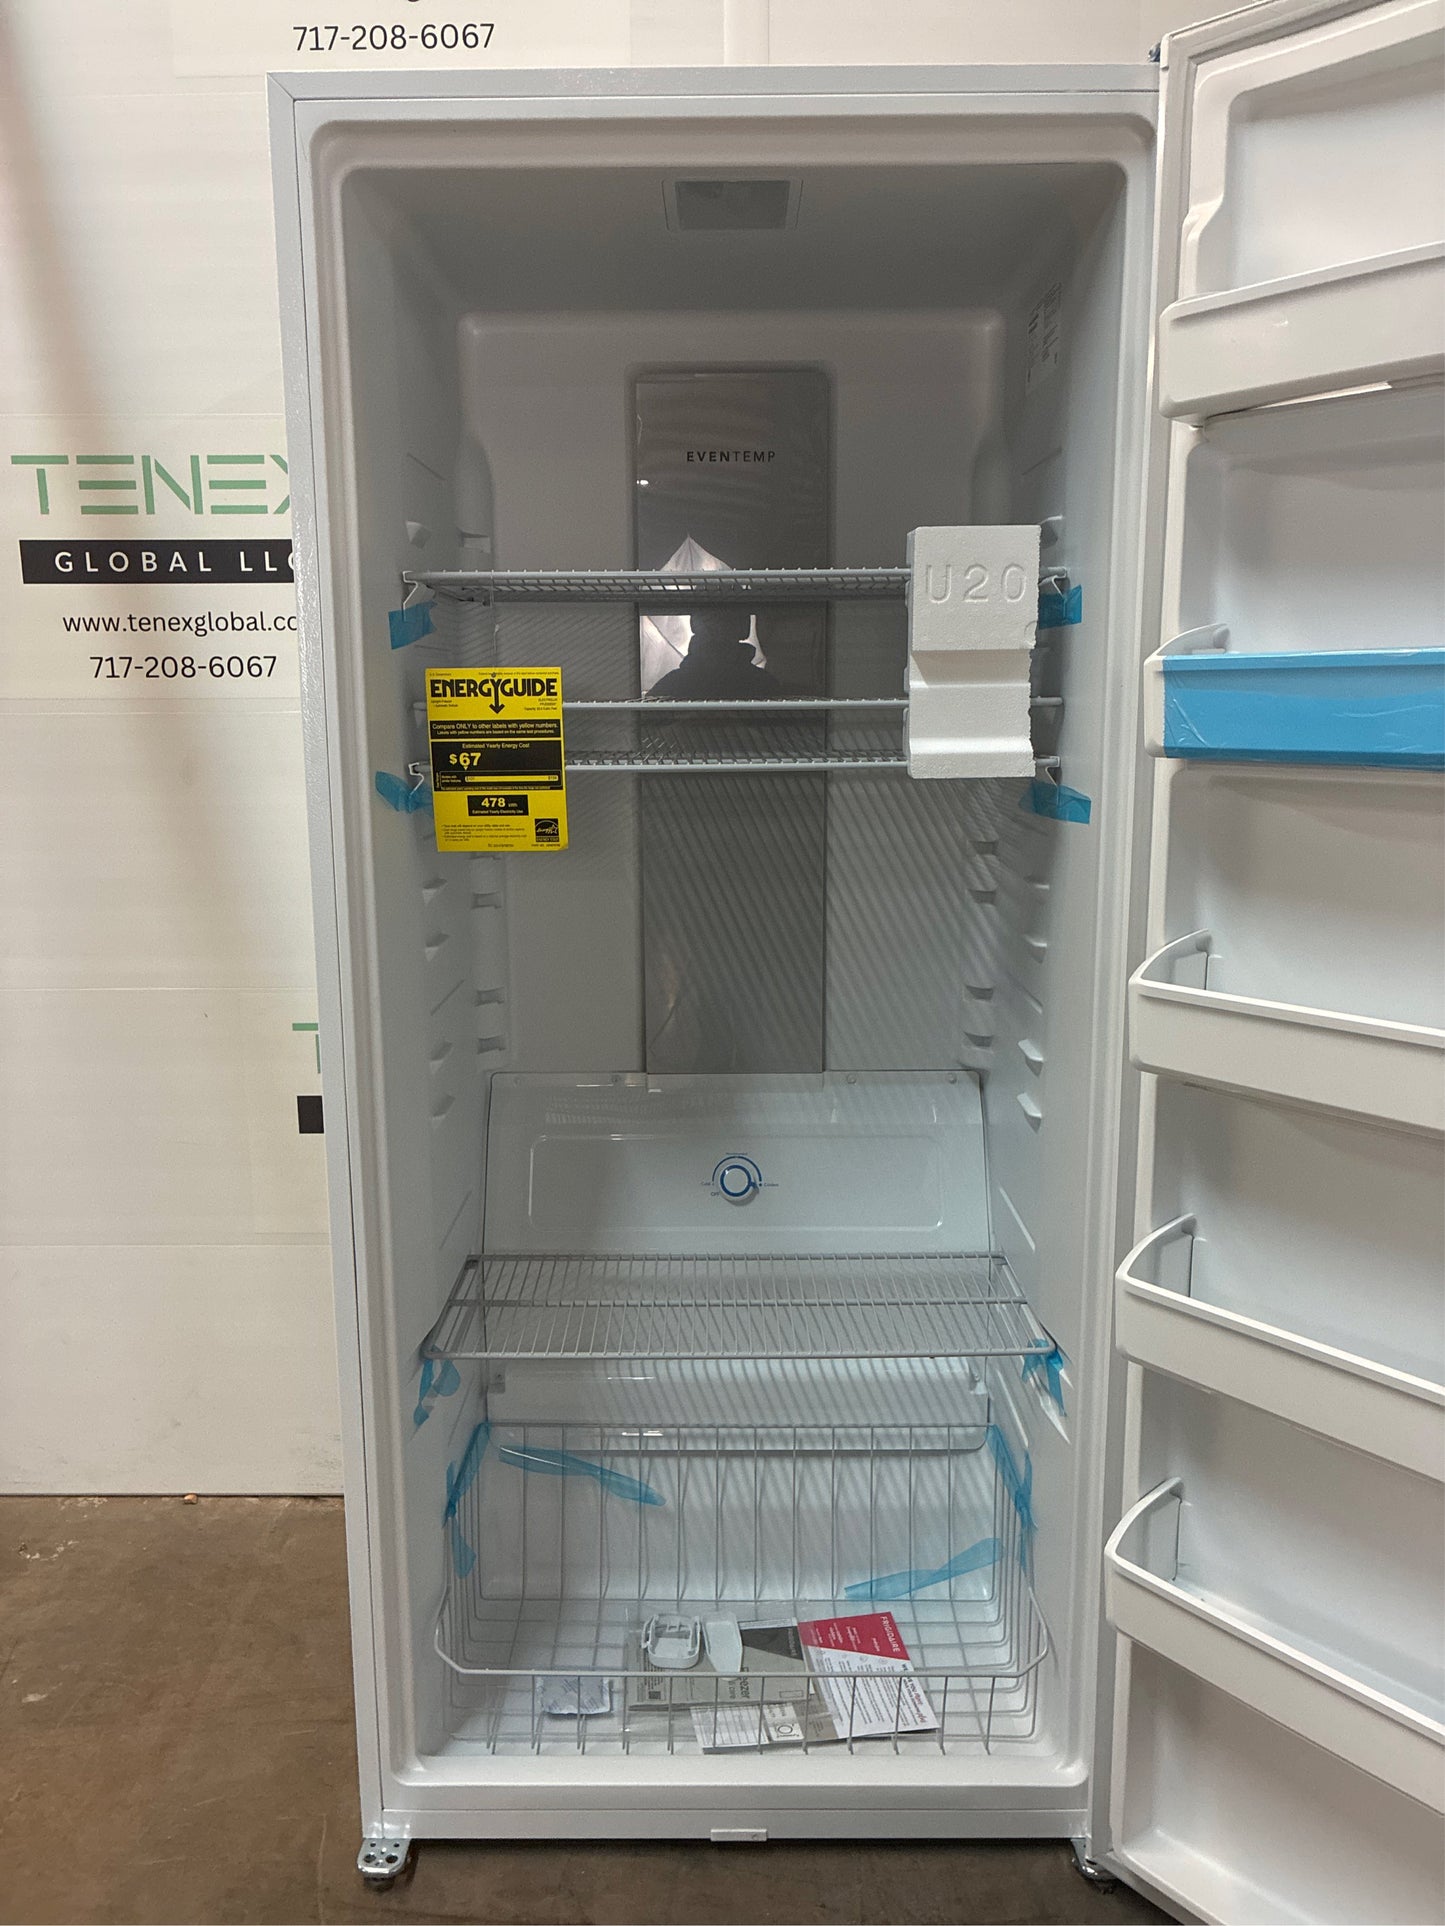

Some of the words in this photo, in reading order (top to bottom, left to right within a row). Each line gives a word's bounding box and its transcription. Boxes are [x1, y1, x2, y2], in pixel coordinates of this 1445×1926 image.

[293, 23, 495, 51] 717-208-6067
[686, 451, 776, 462] EVENTEMP
[54, 551, 212, 573] GLOBAL
[925, 563, 1027, 604] U20
[89, 655, 277, 679] 717-208-6067
[430, 678, 558, 698] ENERGYGUIDE
[449, 752, 481, 766] $67
[481, 797, 506, 808] 478
[880, 1616, 900, 1653] FRIGIDAIRE
[740, 1666, 750, 1699] Feezer
